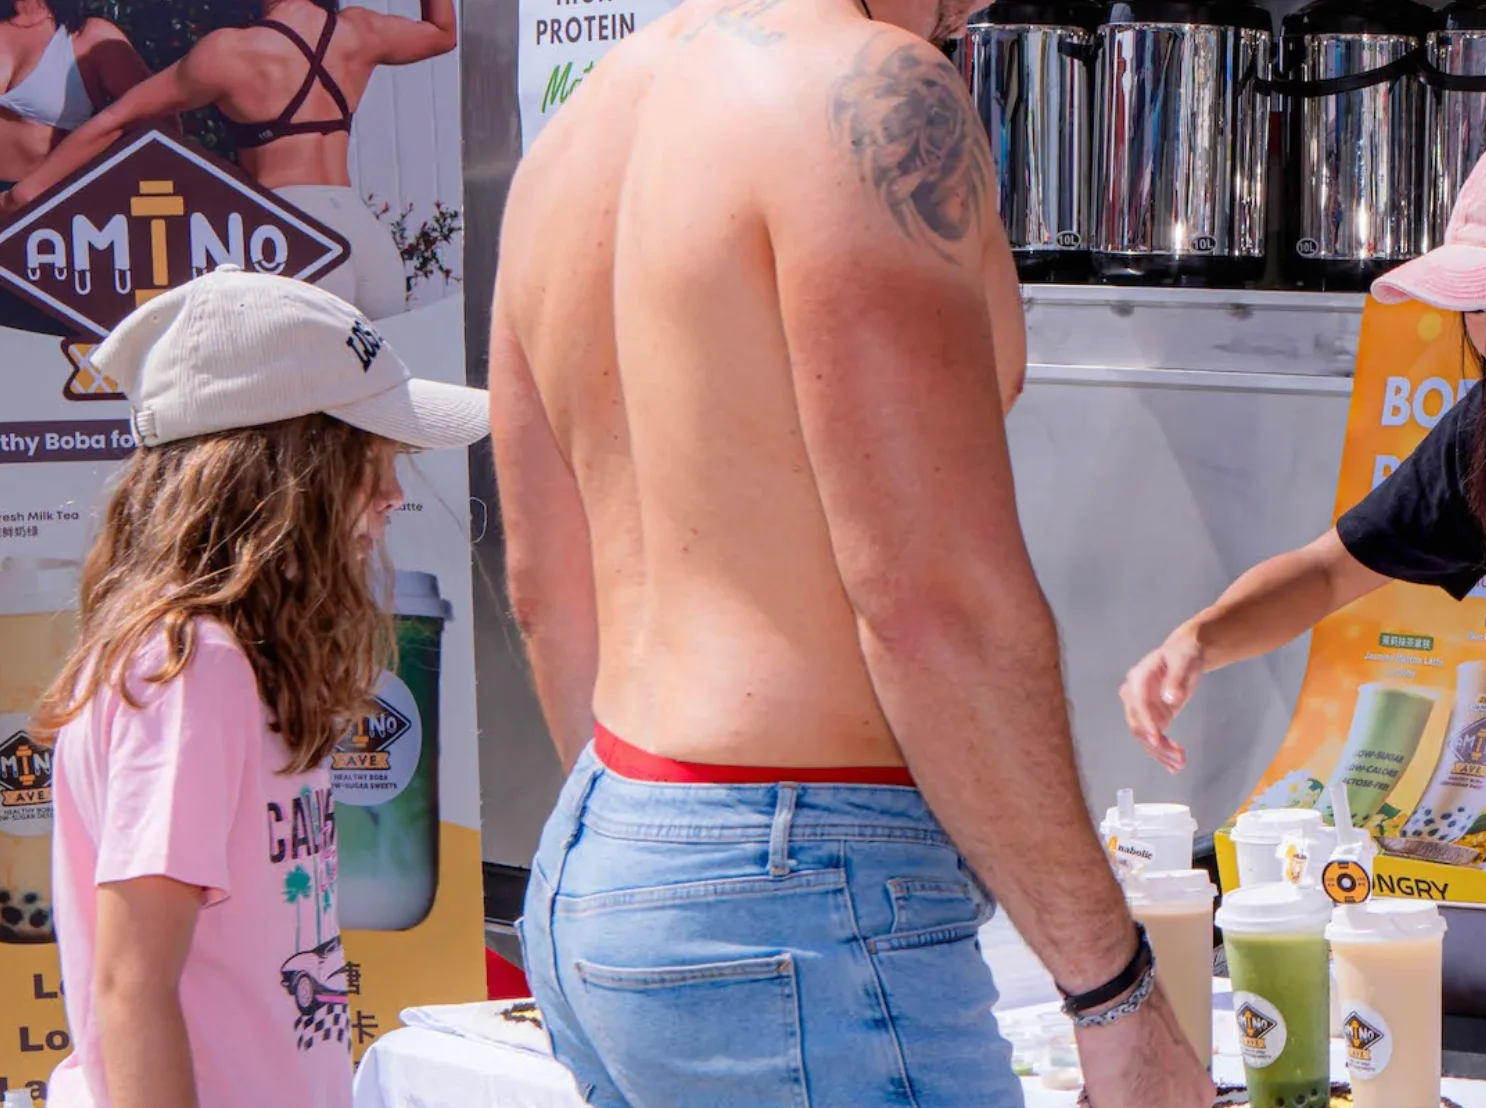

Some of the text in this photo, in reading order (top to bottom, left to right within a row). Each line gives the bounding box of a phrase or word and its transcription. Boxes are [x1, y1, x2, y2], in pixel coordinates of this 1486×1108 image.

[536, 13, 635, 45] PROTEIN
[26, 181, 288, 300] AMINO
[1060, 234, 1077, 246] 10L
[1195, 238, 1213, 250] 10L
[45, 432, 105, 450] Boba
[27, 511, 53, 521] Milk
[56, 510, 80, 520] Tea
[346, 755, 377, 766] AVE
[16, 790, 46, 802] AVE
